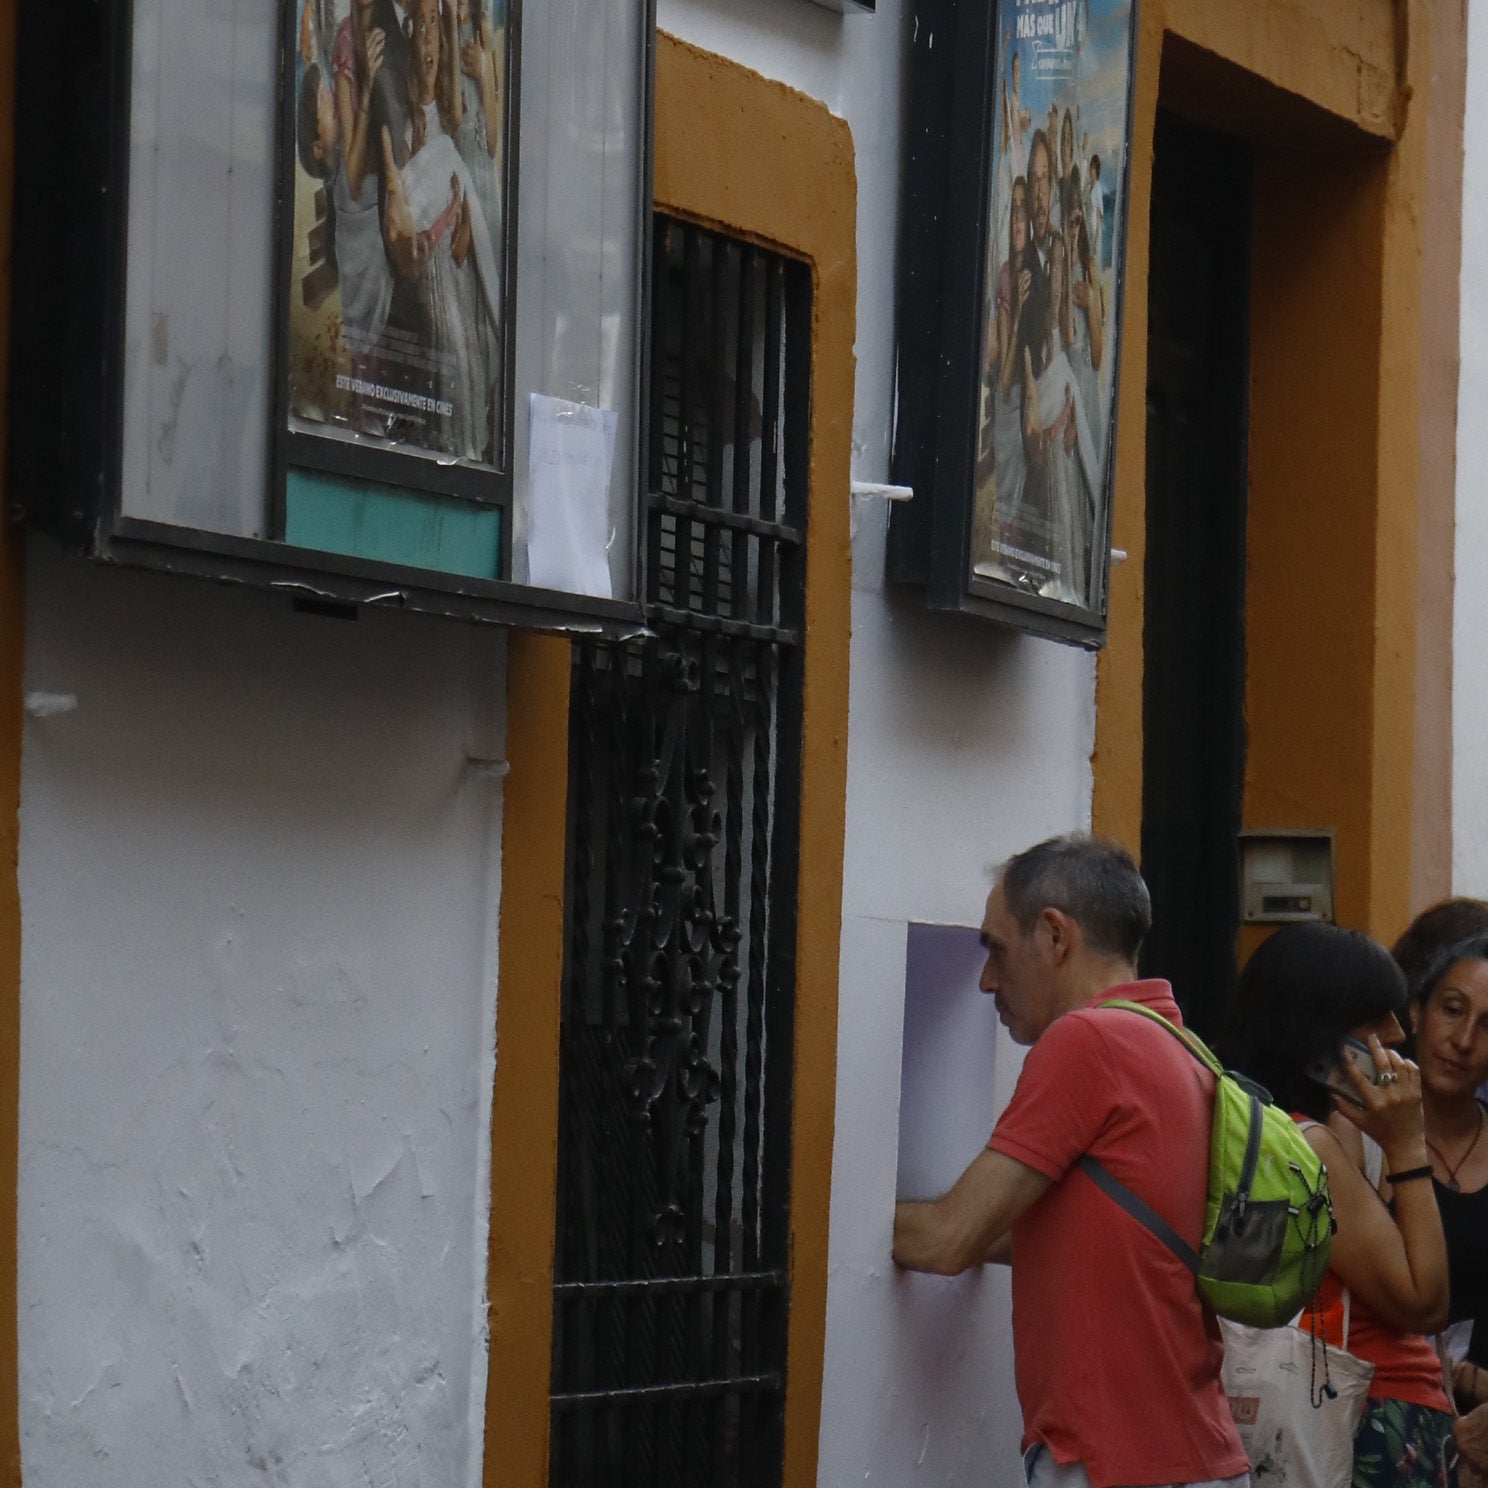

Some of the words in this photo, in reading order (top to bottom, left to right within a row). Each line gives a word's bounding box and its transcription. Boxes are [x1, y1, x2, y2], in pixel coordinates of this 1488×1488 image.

[1016, 8, 1036, 39] MÁS
[336, 374, 350, 391] ESTE
[351, 378, 375, 397] VERANO
[376, 385, 427, 410] EXCLUSIVAMENTE
[427, 398, 436, 413] EN
